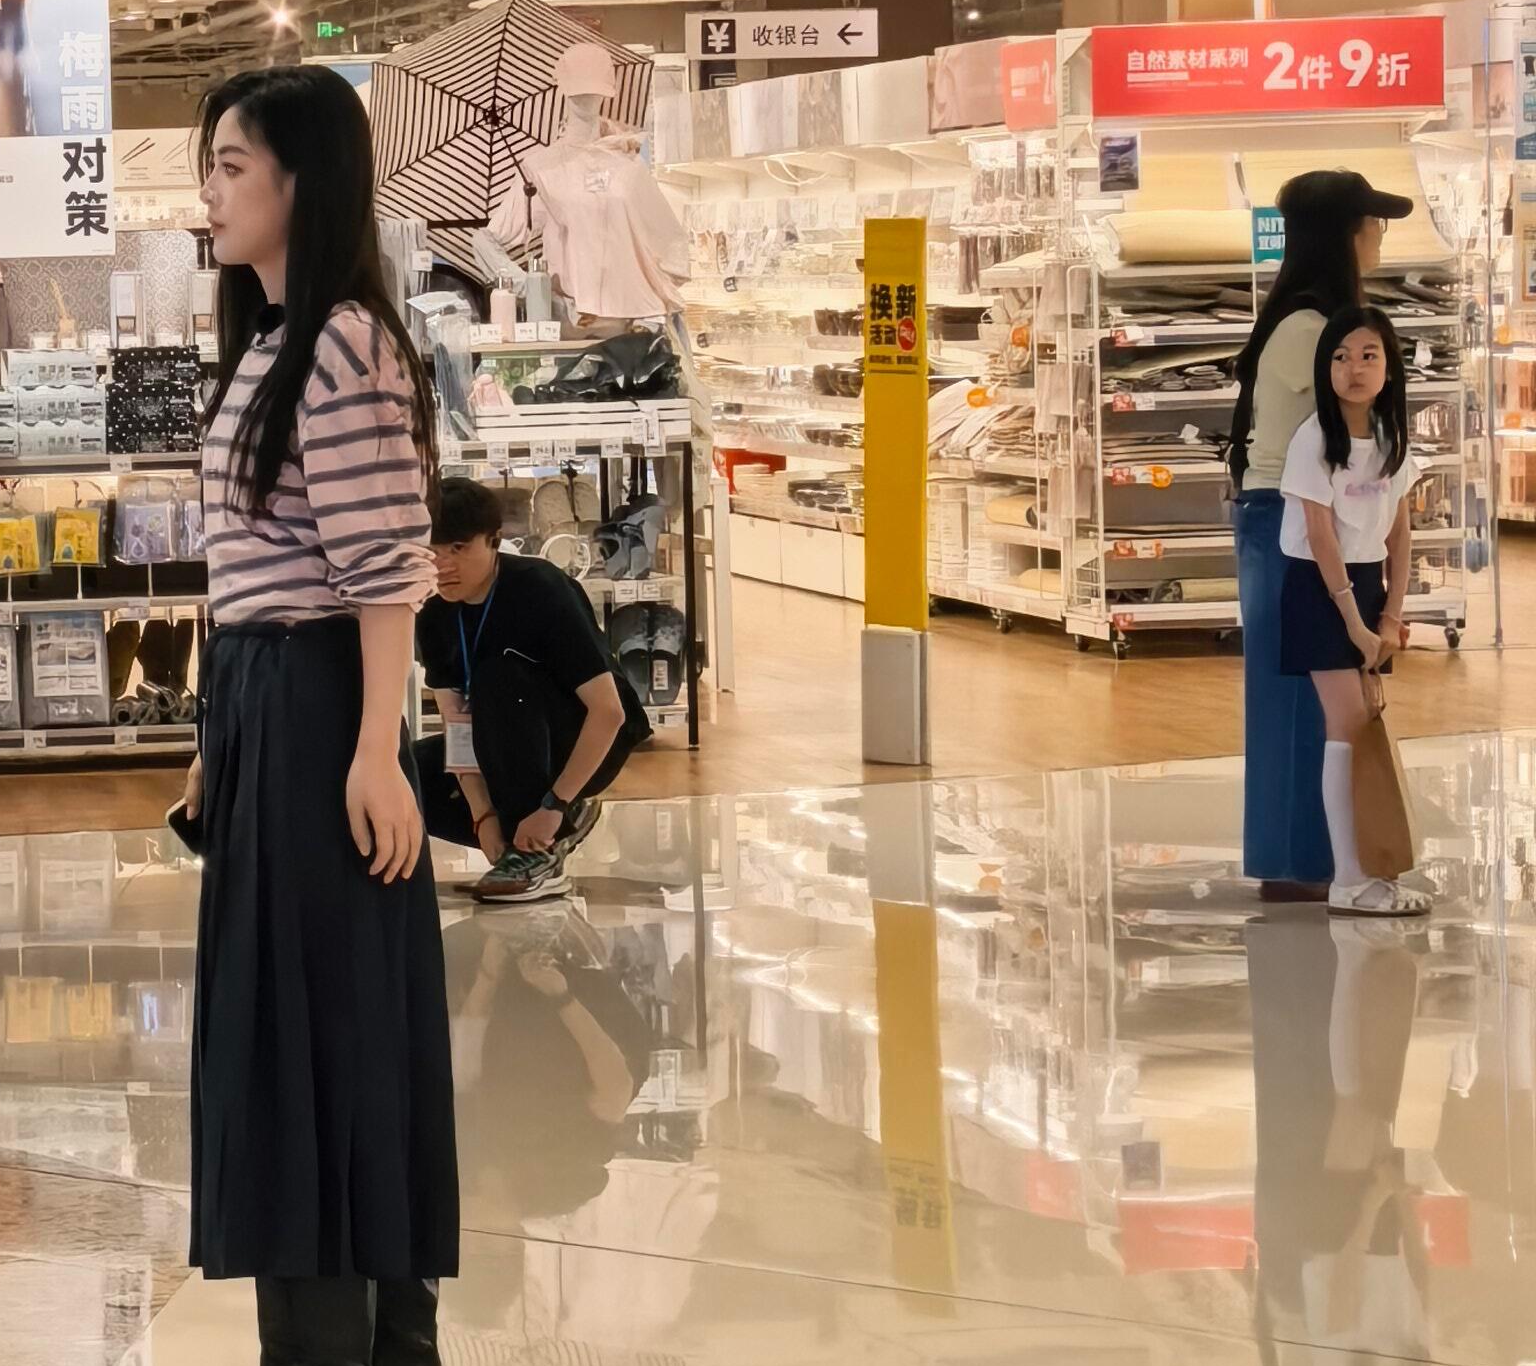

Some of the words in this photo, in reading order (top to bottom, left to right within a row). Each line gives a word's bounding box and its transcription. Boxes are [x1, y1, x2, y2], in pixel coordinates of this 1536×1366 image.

[753, 24, 820, 47] 收银台
[1263, 39, 1411, 91] 2件9折
[58, 31, 110, 237] 梅雨对策
